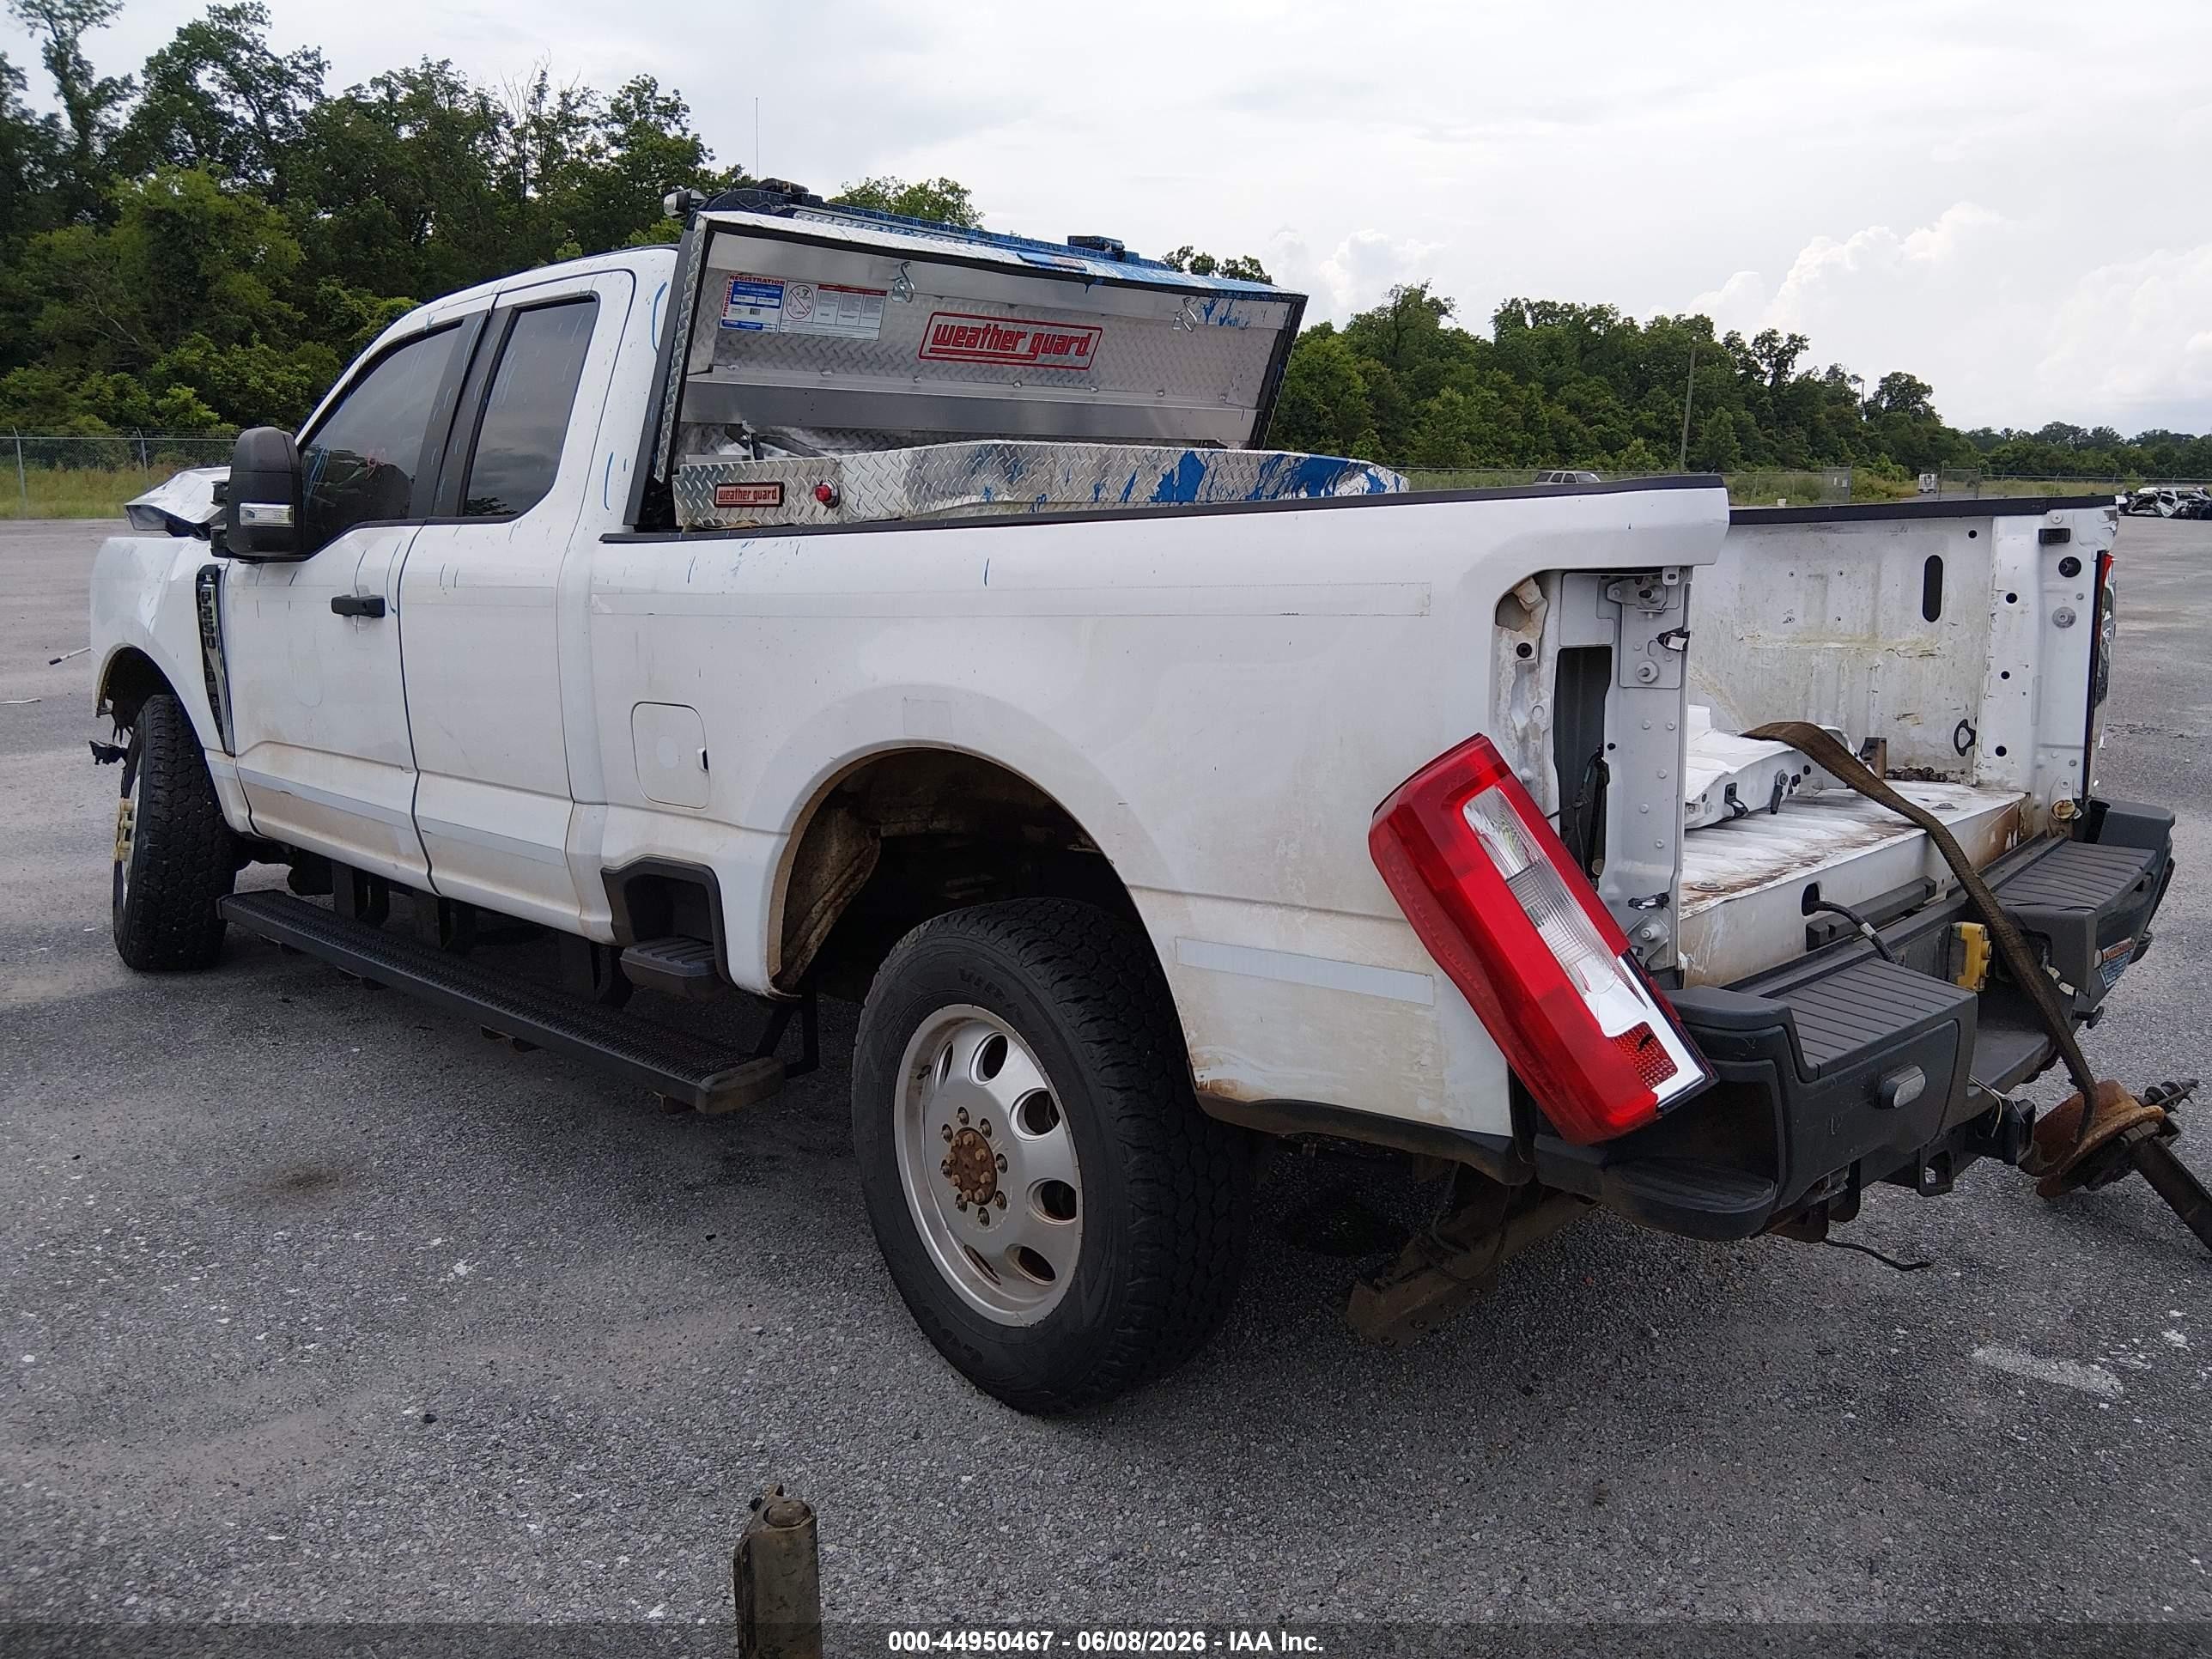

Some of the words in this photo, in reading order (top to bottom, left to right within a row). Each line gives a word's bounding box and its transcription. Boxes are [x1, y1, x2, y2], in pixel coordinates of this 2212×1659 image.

[722, 281, 733, 318] PRODUCT
[729, 275, 786, 286] REGISTRATION
[932, 323, 1028, 352] weather
[1028, 332, 1093, 361] guard
[718, 487, 752, 501] weather
[752, 487, 777, 502] guard
